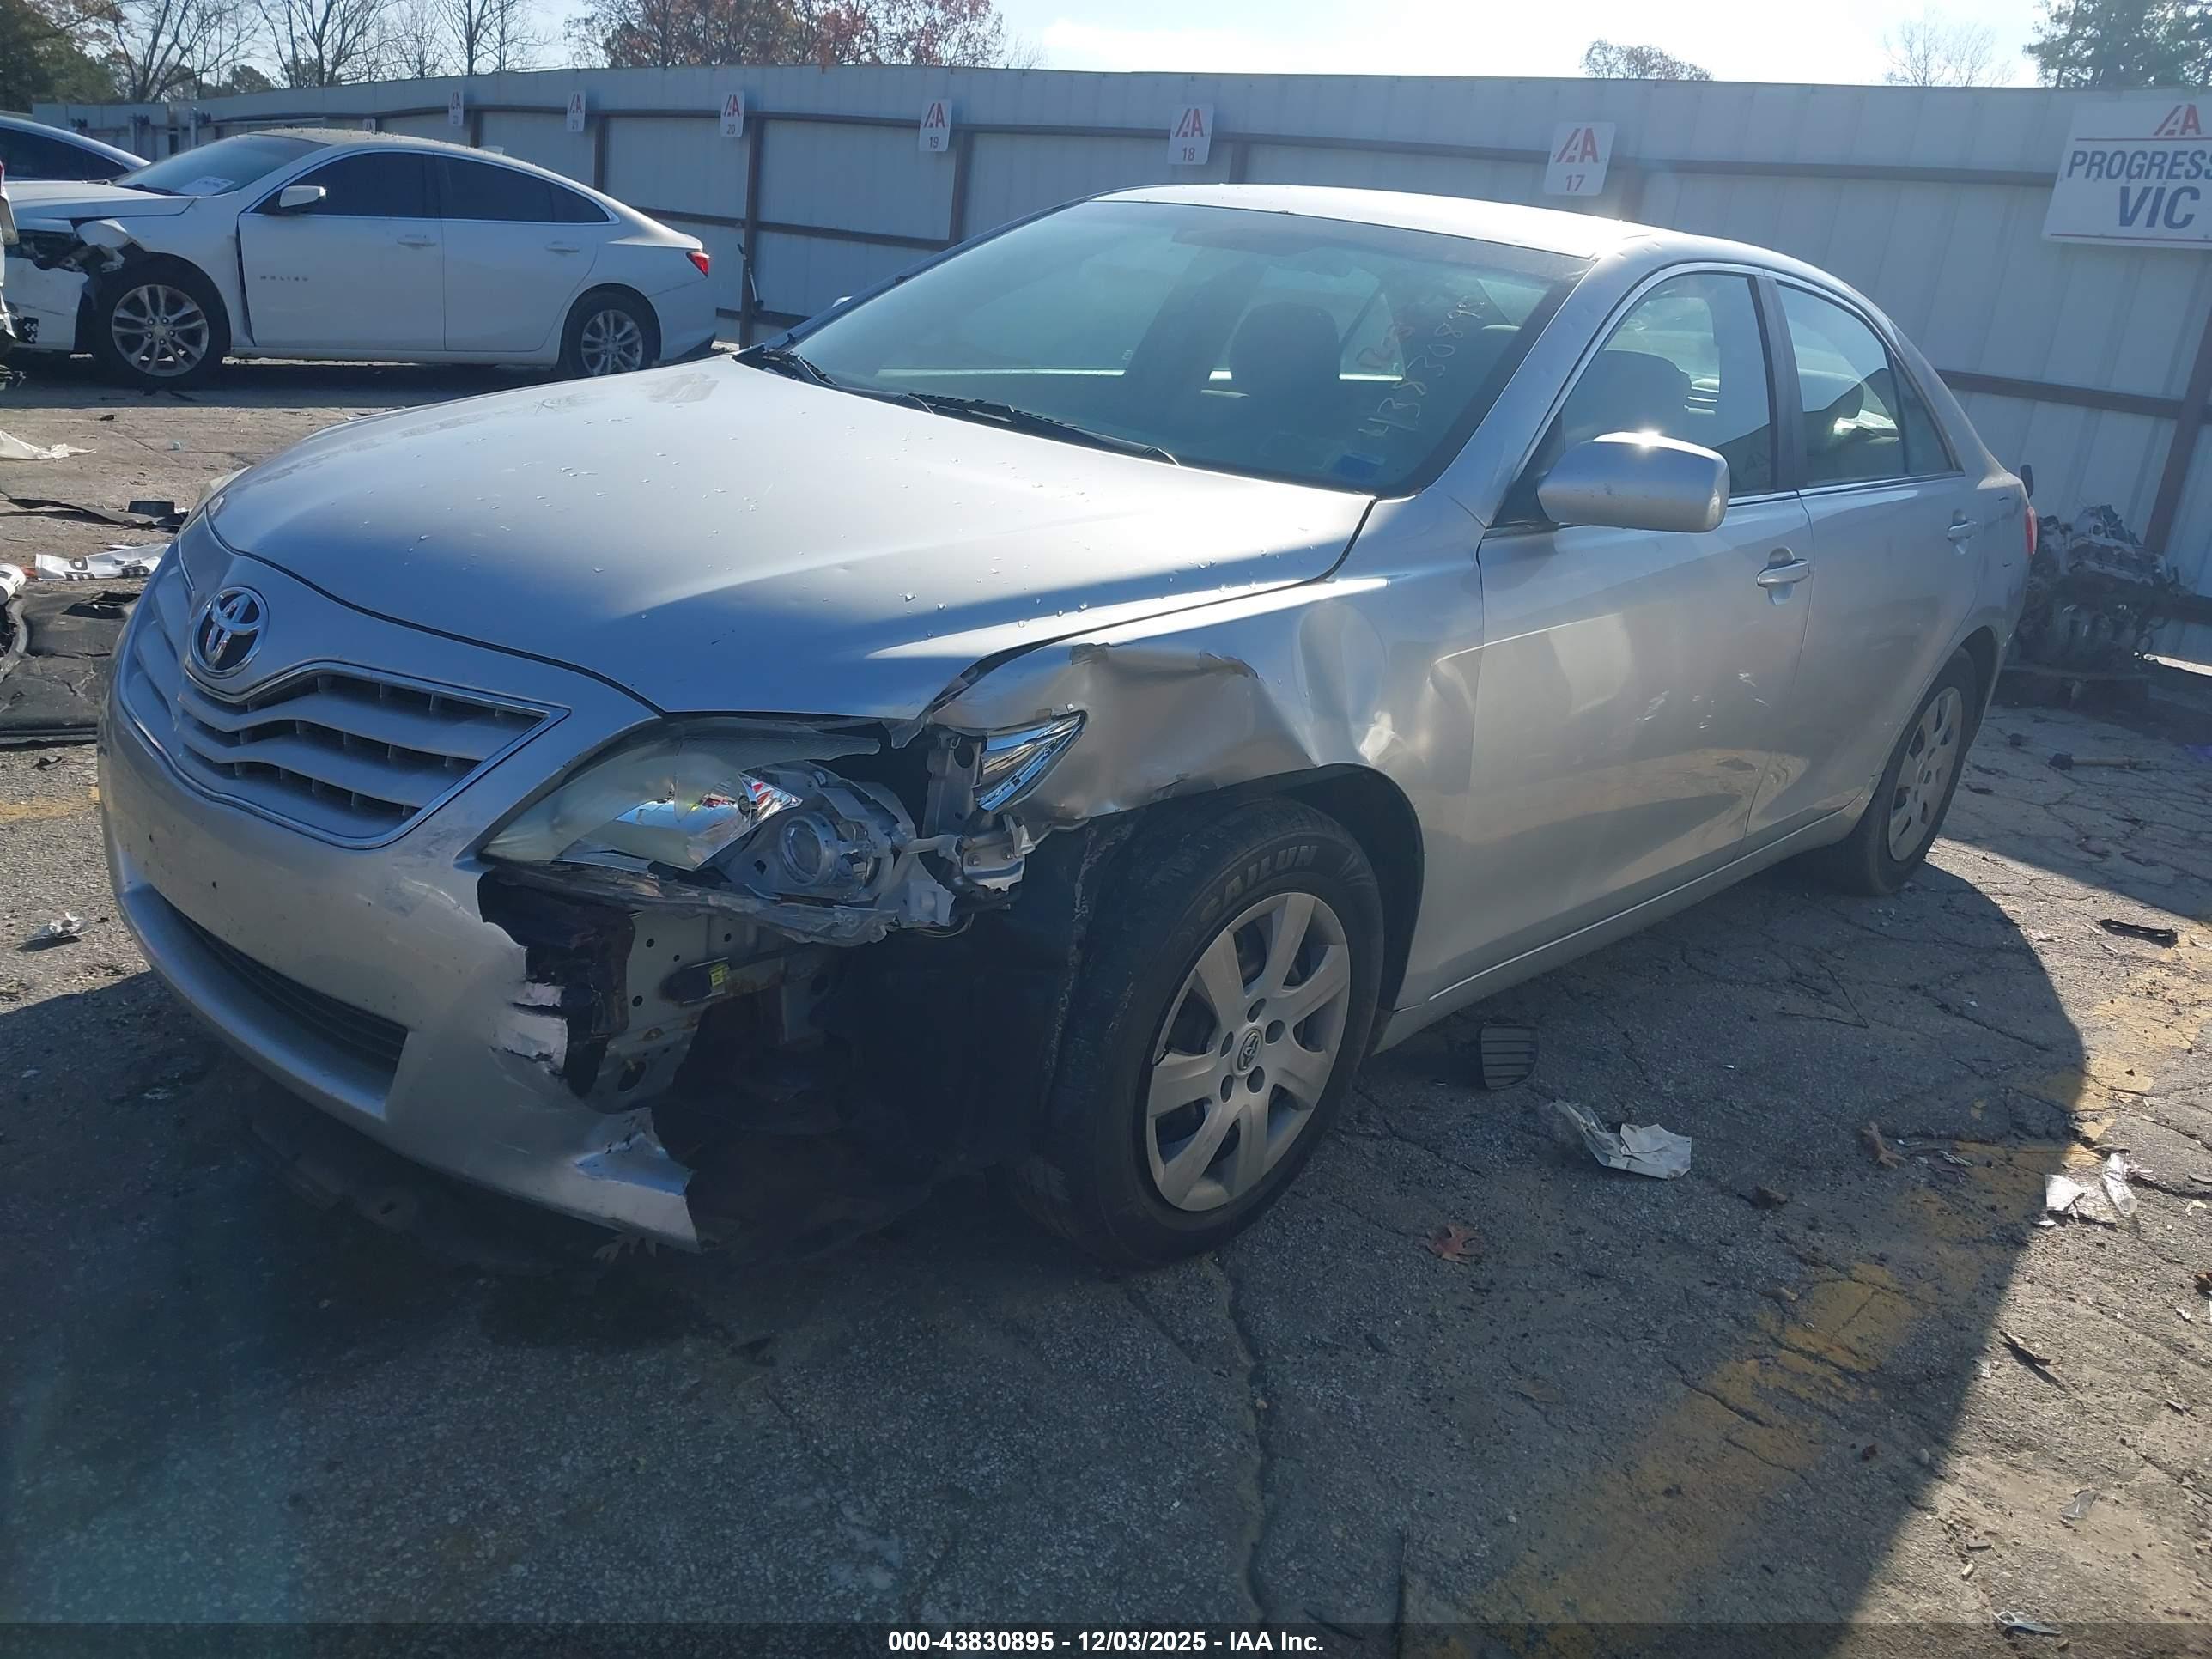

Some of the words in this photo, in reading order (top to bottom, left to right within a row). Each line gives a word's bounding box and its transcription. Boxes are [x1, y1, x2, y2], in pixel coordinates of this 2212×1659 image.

[726, 124, 736, 135] 20
[929, 136, 939, 149] 19
[1182, 147, 1196, 161] 18
[1565, 174, 1585, 192] 17
[2118, 185, 2201, 229] VIC
